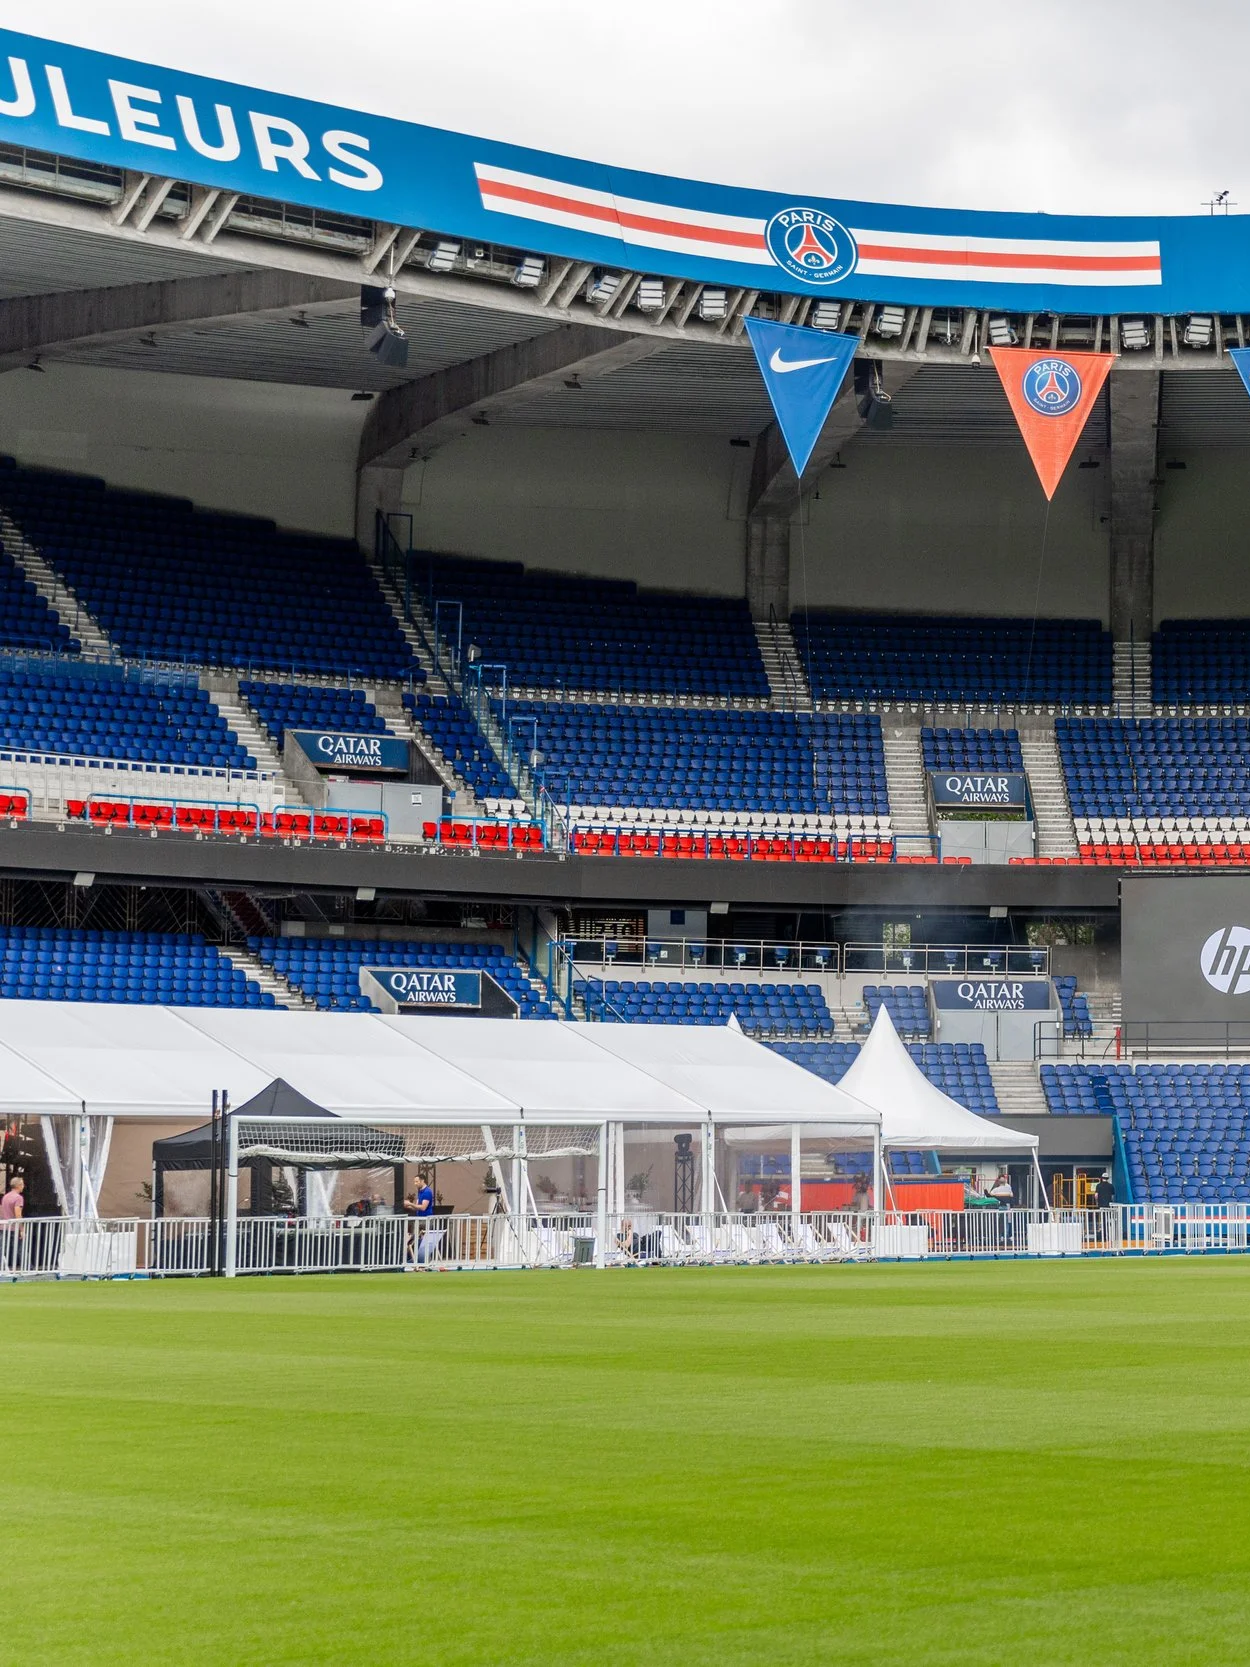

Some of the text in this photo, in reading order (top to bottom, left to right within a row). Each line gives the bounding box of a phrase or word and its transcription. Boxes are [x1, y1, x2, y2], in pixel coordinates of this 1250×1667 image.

[778, 211, 836, 232] PARIS
[1033, 362, 1071, 377] PARIS
[318, 735, 381, 756] QATAR
[333, 753, 382, 766] AIRWAYS
[945, 777, 1009, 795] QATAR
[961, 792, 1010, 803] AIRWAYS
[390, 973, 456, 994] QATAR
[407, 991, 456, 1003] AIRWAYS
[957, 982, 1024, 1002] QATAR
[974, 999, 1025, 1010] AIRWAYS
